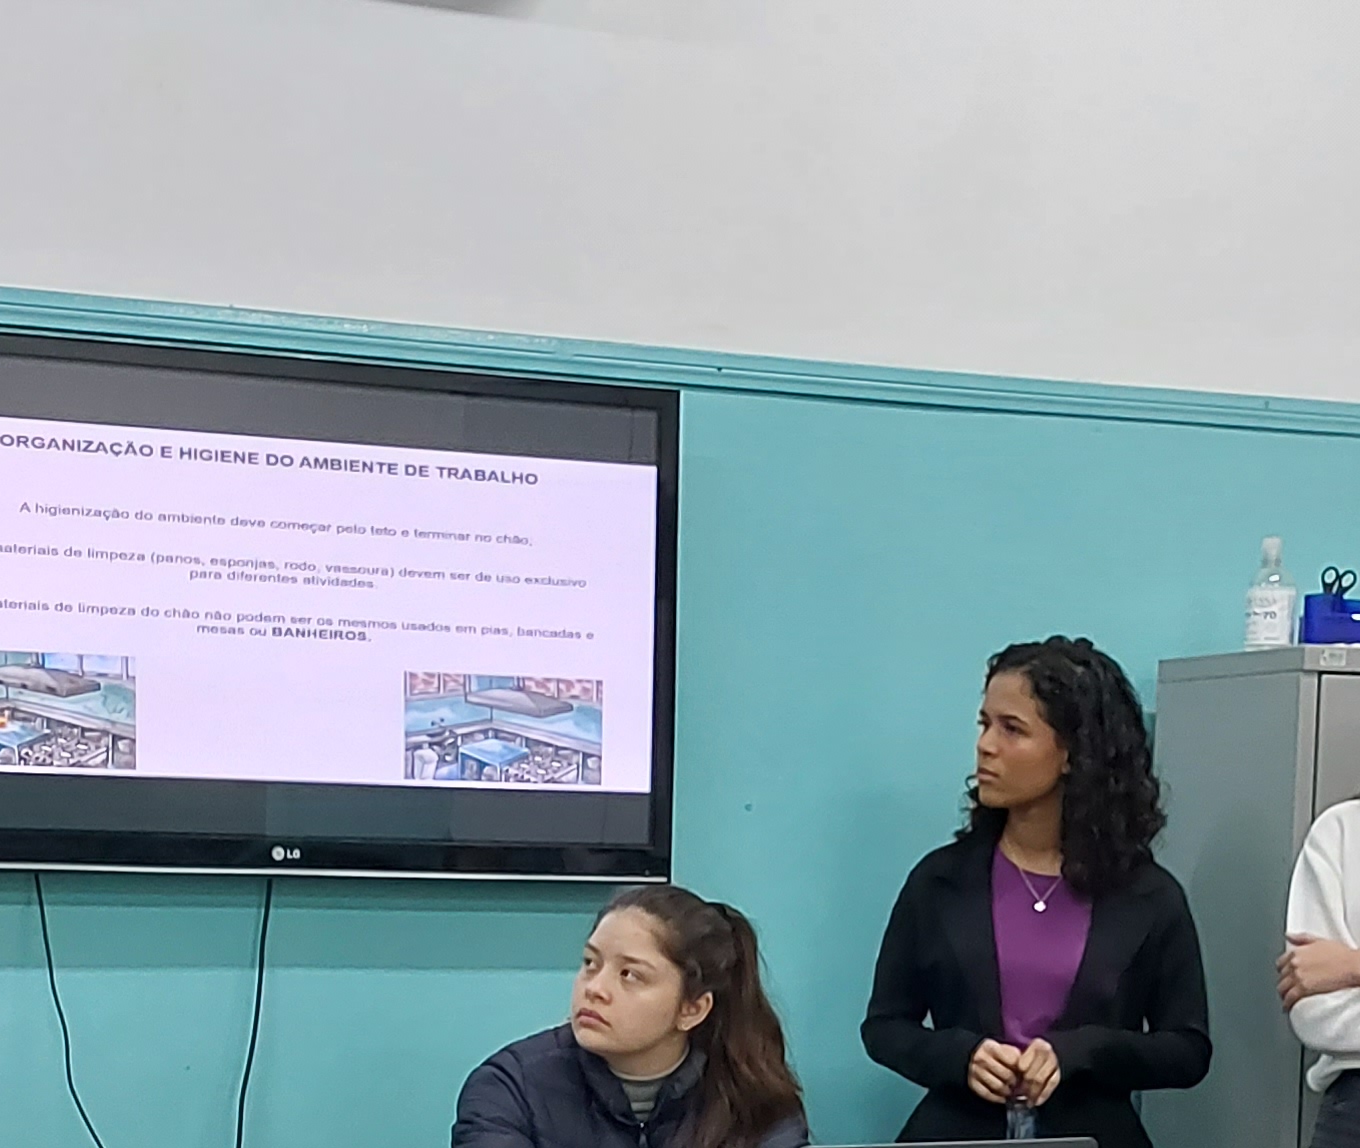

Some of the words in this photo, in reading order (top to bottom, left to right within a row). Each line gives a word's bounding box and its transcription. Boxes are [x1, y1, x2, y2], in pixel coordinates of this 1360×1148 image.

[0, 434, 154, 457] ORGANIZAÇÃO
[160, 446, 173, 458] E
[179, 447, 260, 465] HIGIENE
[266, 454, 294, 468] DO
[299, 456, 398, 476] AMBIENTE
[404, 464, 430, 477] DE
[436, 466, 538, 485] TRABALHO
[19, 502, 31, 513] A
[35, 503, 130, 521] higienização
[135, 510, 153, 521] do
[158, 512, 226, 526] ambiente
[230, 516, 266, 528] deve
[336, 523, 366, 537] pelo
[371, 525, 397, 537] teto
[401, 529, 410, 538] e
[414, 528, 471, 542] terminar
[475, 533, 492, 543] no
[64, 546, 83, 558] de
[87, 547, 146, 562] limpeza
[398, 567, 446, 581] devem
[450, 571, 471, 582] ser
[475, 571, 492, 583] de
[496, 574, 521, 585] uso
[524, 574, 588, 589] exclusivo
[189, 569, 223, 581] para
[227, 570, 299, 585] diferentes
[54, 601, 73, 614] de
[78, 602, 136, 618] limpeza
[140, 606, 160, 618] do
[164, 607, 200, 620] chão
[204, 610, 232, 622] não
[236, 612, 286, 625] podem
[290, 616, 312, 626] ser
[316, 617, 334, 627] os
[338, 617, 398, 631] mesmos
[401, 619, 451, 634] usados
[455, 624, 477, 635] em
[517, 626, 582, 641] bancadas
[586, 631, 595, 641] e
[196, 625, 245, 636] mesas
[249, 627, 267, 637] ou
